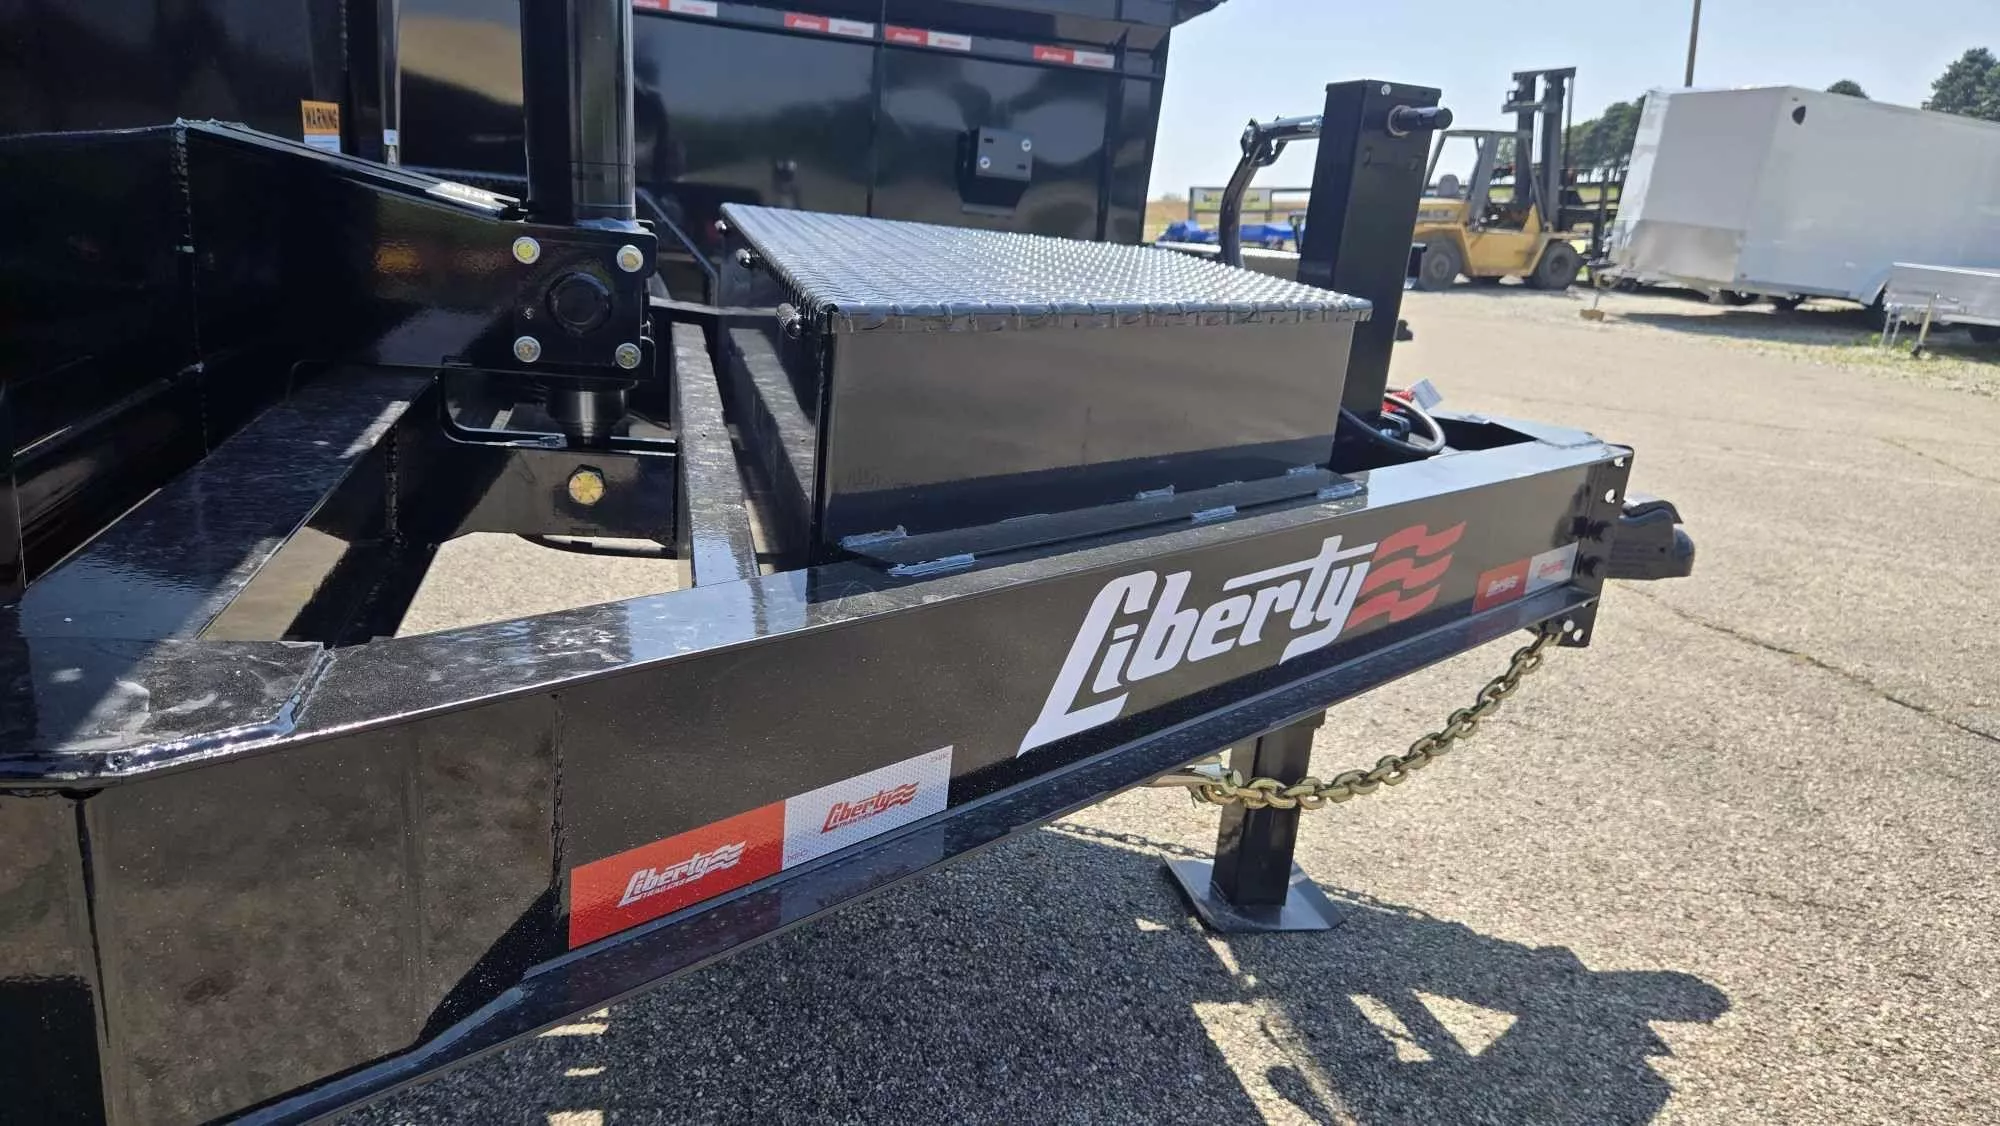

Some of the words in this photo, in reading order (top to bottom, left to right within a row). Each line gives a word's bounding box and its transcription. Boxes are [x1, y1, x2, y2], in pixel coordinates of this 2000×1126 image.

[304, 107, 338, 129] WARNING
[1016, 534, 1378, 758] Liberty
[820, 790, 894, 834] Liberty
[616, 851, 714, 908] Liberty
